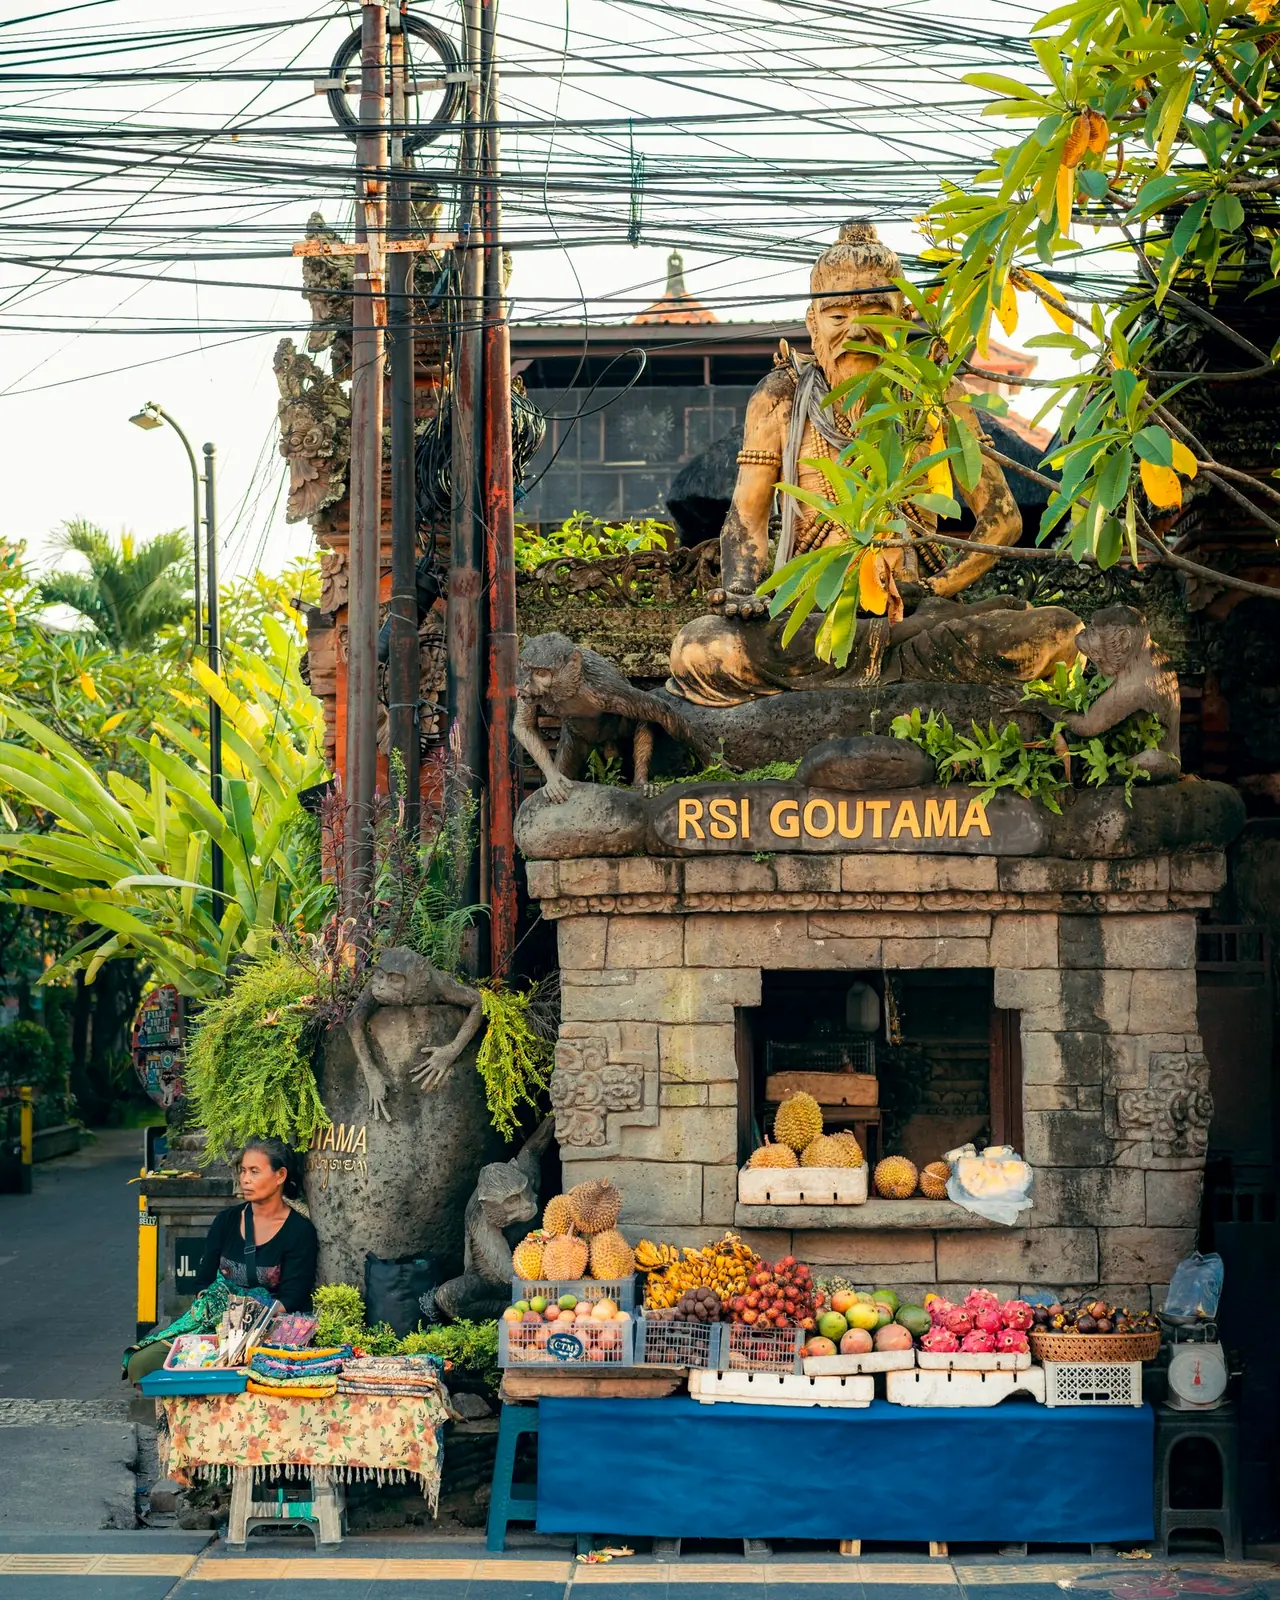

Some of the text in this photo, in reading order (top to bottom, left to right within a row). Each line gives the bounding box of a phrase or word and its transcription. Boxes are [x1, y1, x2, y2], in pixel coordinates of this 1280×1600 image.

[677, 797, 992, 840] RSI GOUTAMA
[176, 1255, 197, 1277] JL.
[554, 1341, 575, 1352] CTM
